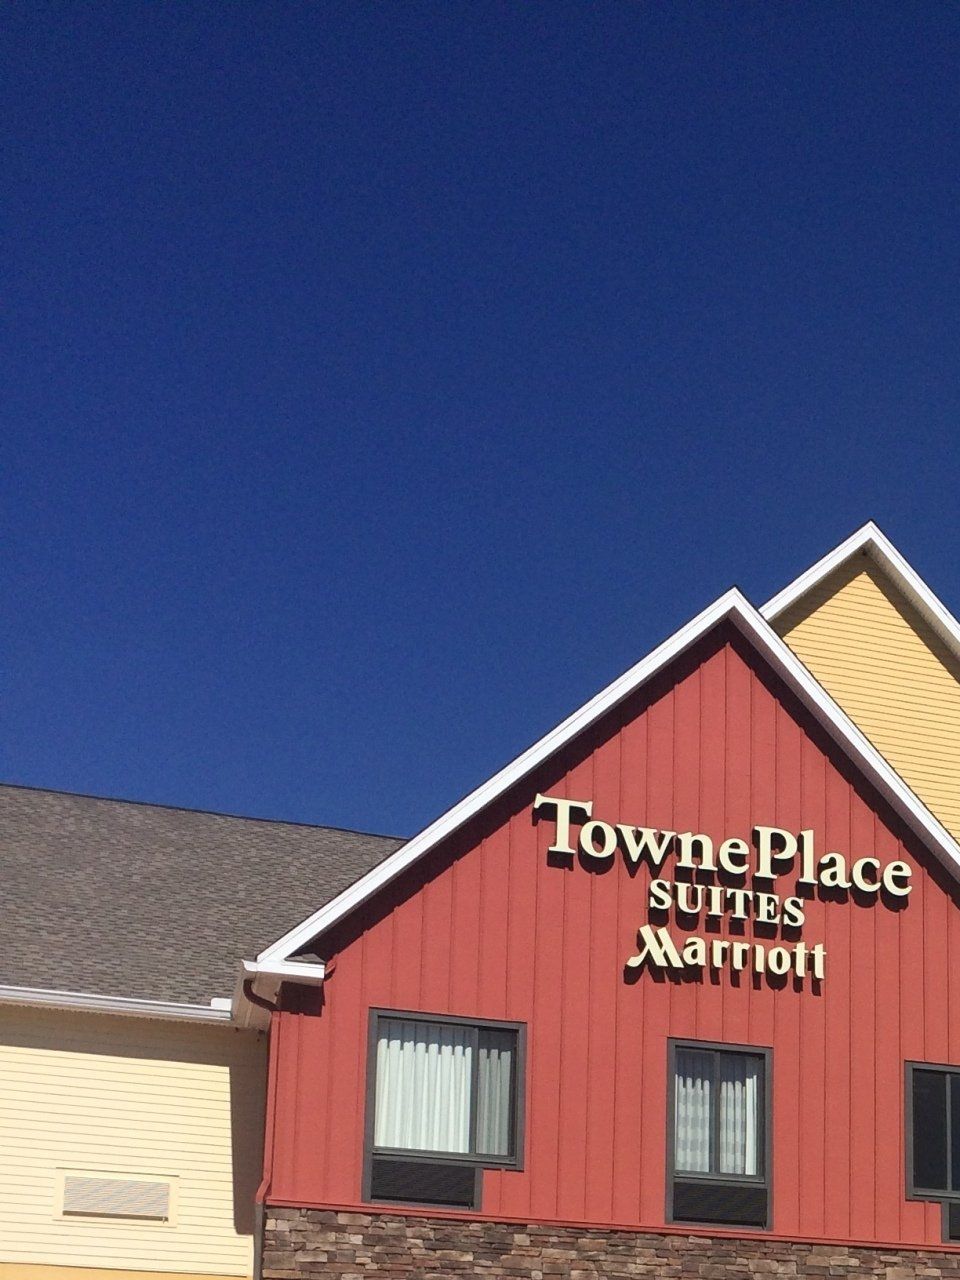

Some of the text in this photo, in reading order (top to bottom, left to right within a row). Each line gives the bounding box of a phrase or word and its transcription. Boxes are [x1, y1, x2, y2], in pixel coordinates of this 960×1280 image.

[534, 793, 913, 896] TownePlace
[649, 878, 805, 927] SUITES
[626, 924, 827, 979] Marriott
